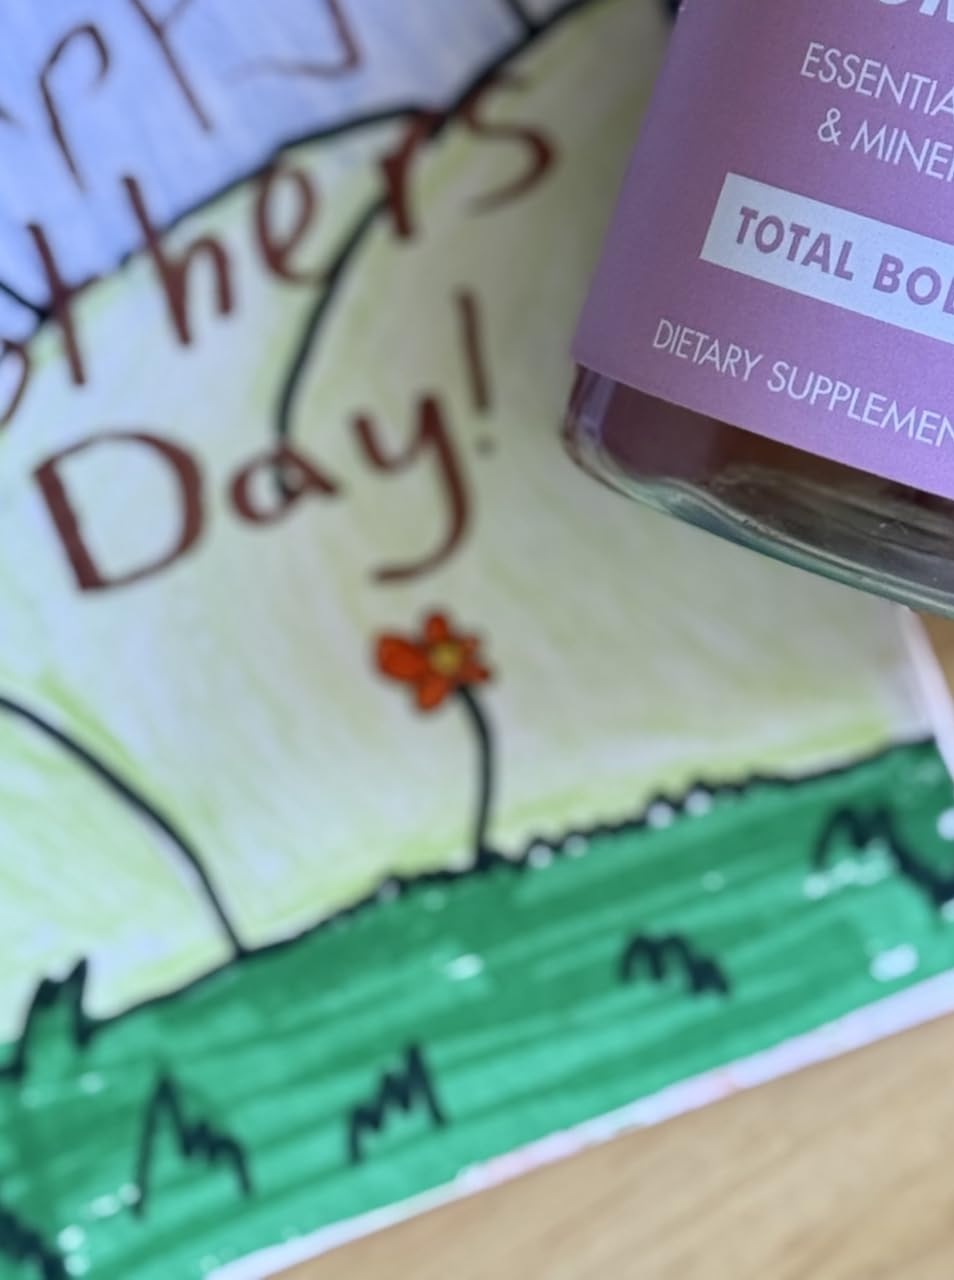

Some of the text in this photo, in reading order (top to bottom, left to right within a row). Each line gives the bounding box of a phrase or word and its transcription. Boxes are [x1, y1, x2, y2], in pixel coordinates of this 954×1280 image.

[817, 108, 841, 145] &
[735, 206, 854, 281] TOTAL
[652, 319, 762, 382] DIETARY
[33, 285, 492, 592] Day!
